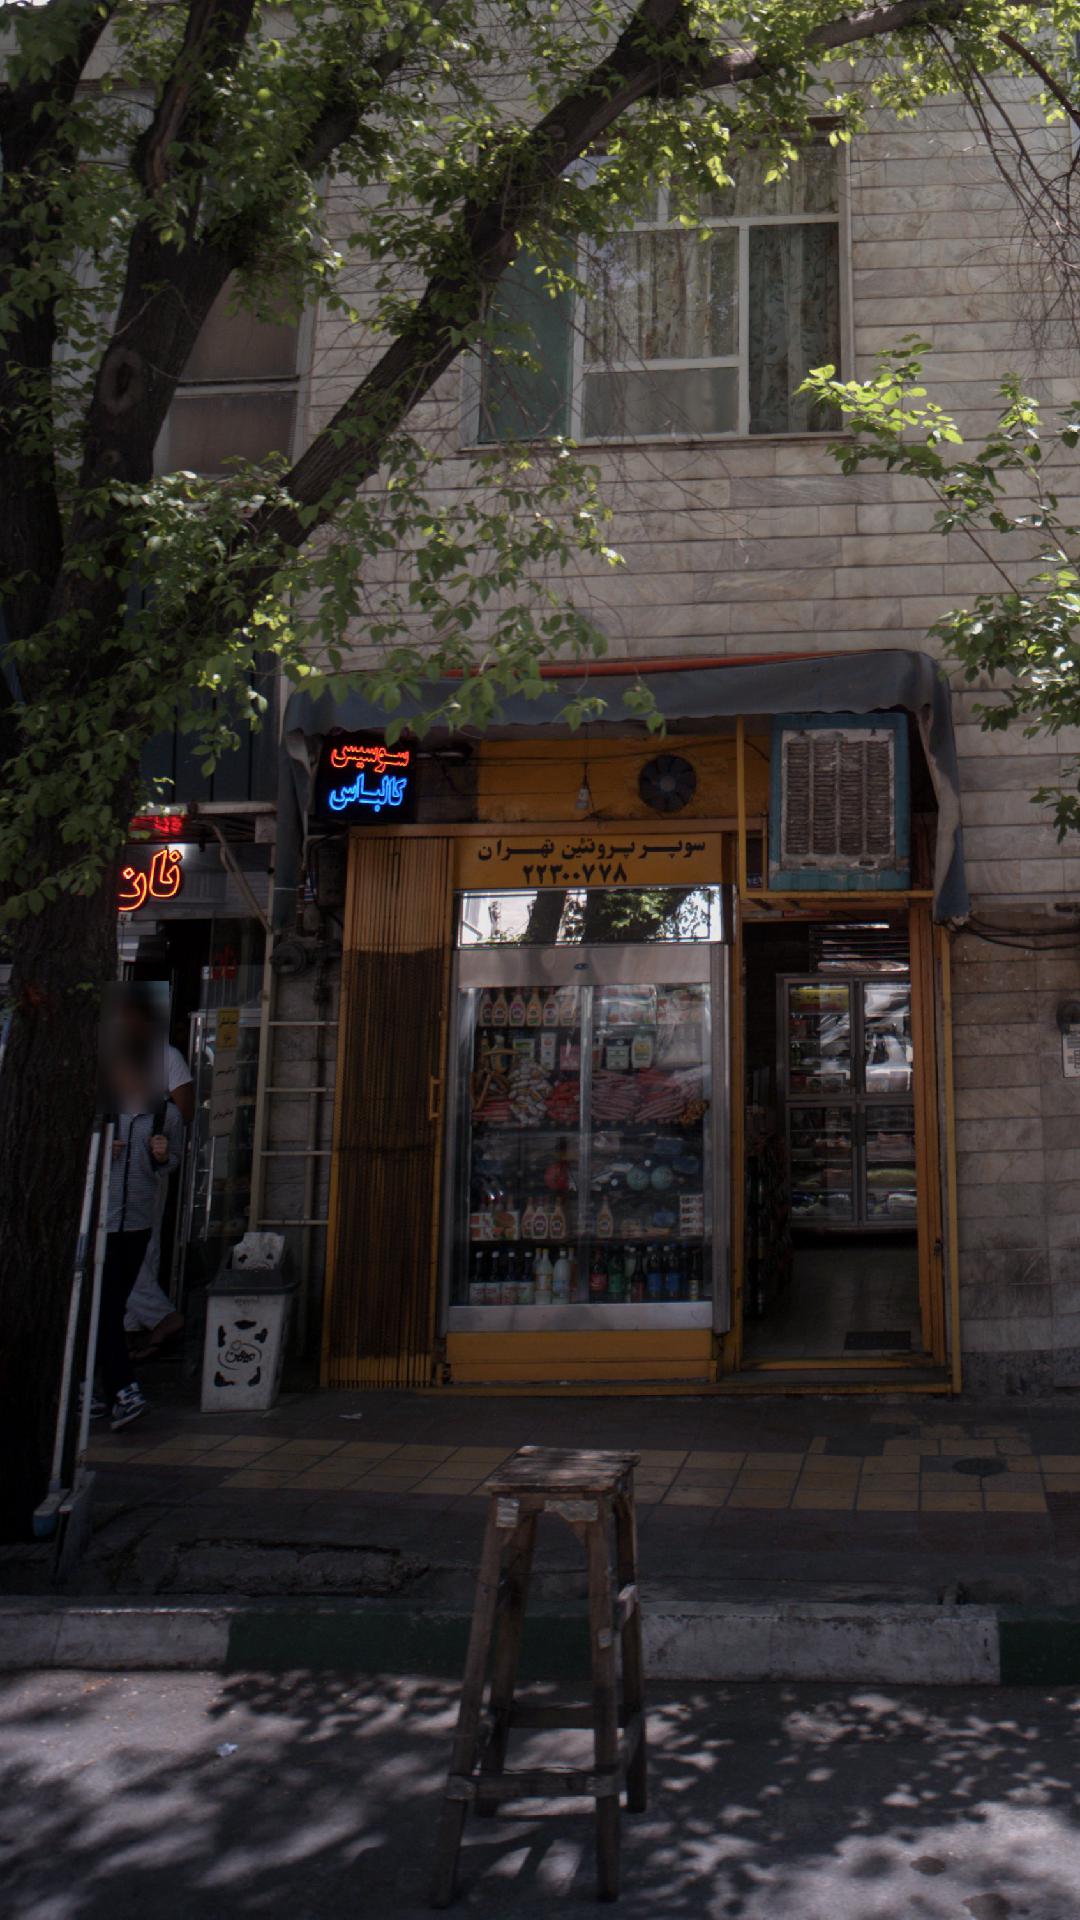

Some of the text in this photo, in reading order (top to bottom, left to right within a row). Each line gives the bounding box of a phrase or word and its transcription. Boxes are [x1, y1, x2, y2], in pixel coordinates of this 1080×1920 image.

[331, 745, 409, 773] سوسیس
[329, 773, 408, 812] کالباس
[477, 837, 705, 861] سوپر پروتئین تهران
[522, 863, 627, 884] ۲۲۳۰۰۷۷۸
